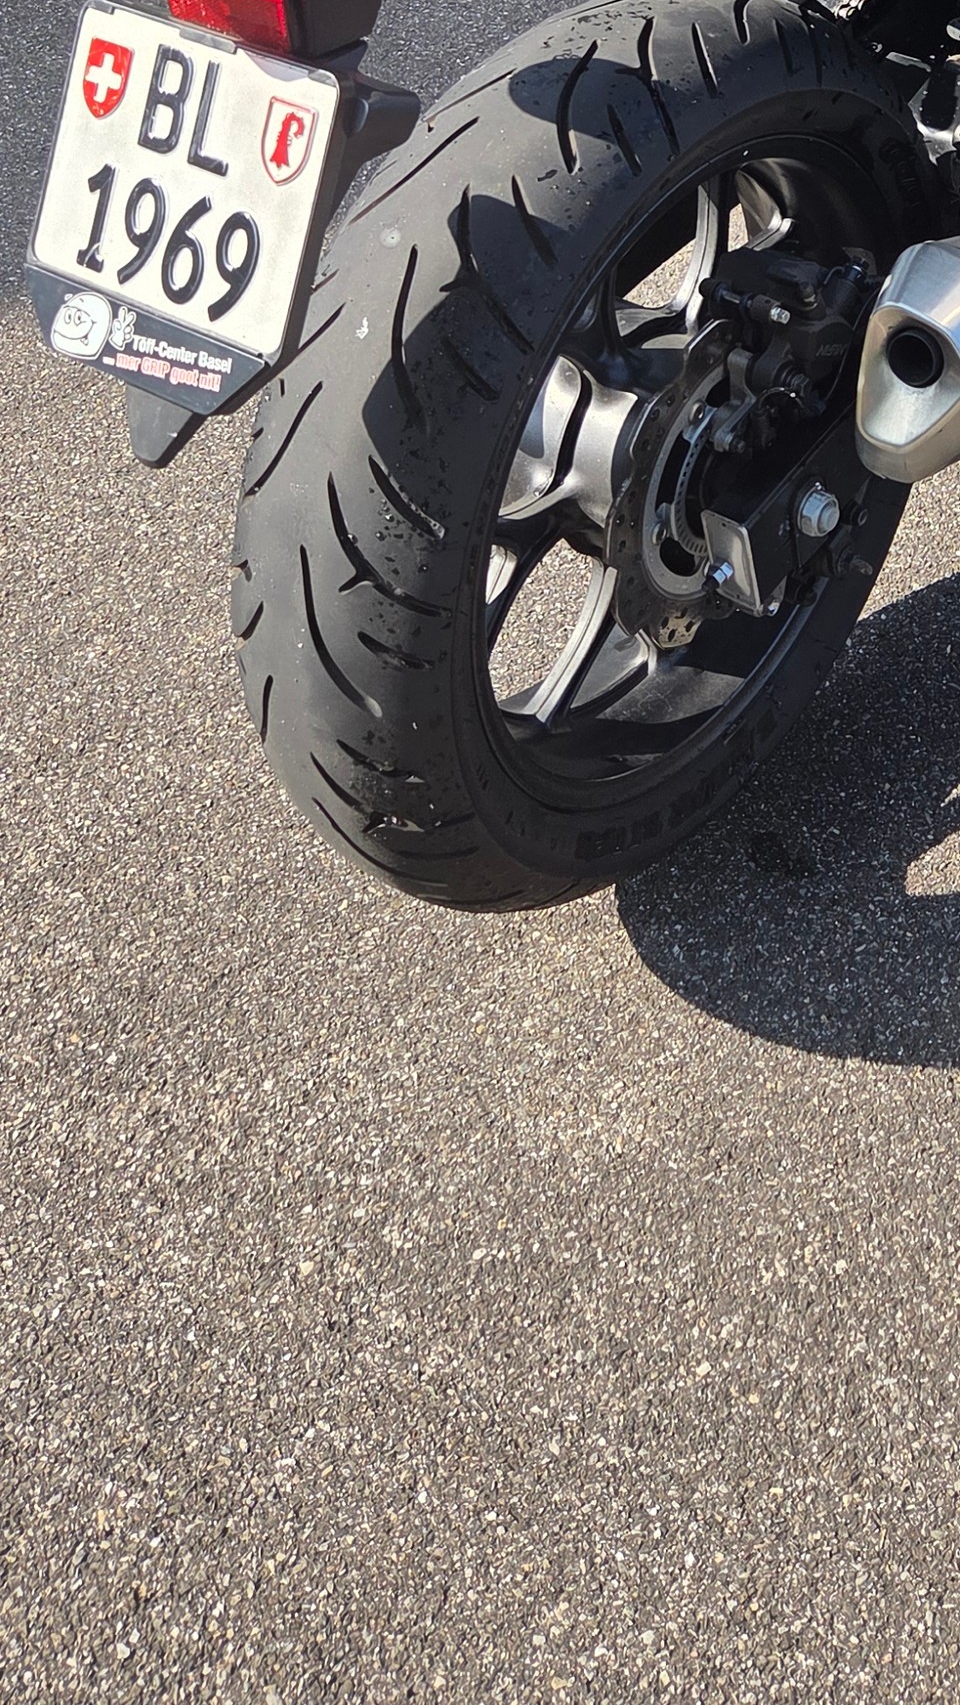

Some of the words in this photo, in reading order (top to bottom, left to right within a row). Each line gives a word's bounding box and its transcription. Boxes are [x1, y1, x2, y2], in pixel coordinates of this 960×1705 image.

[137, 44, 228, 177] BL
[76, 163, 260, 322] 1969
[133, 334, 197, 365] Töff-Center
[198, 350, 232, 374] Basel
[140, 356, 170, 379] GRIP
